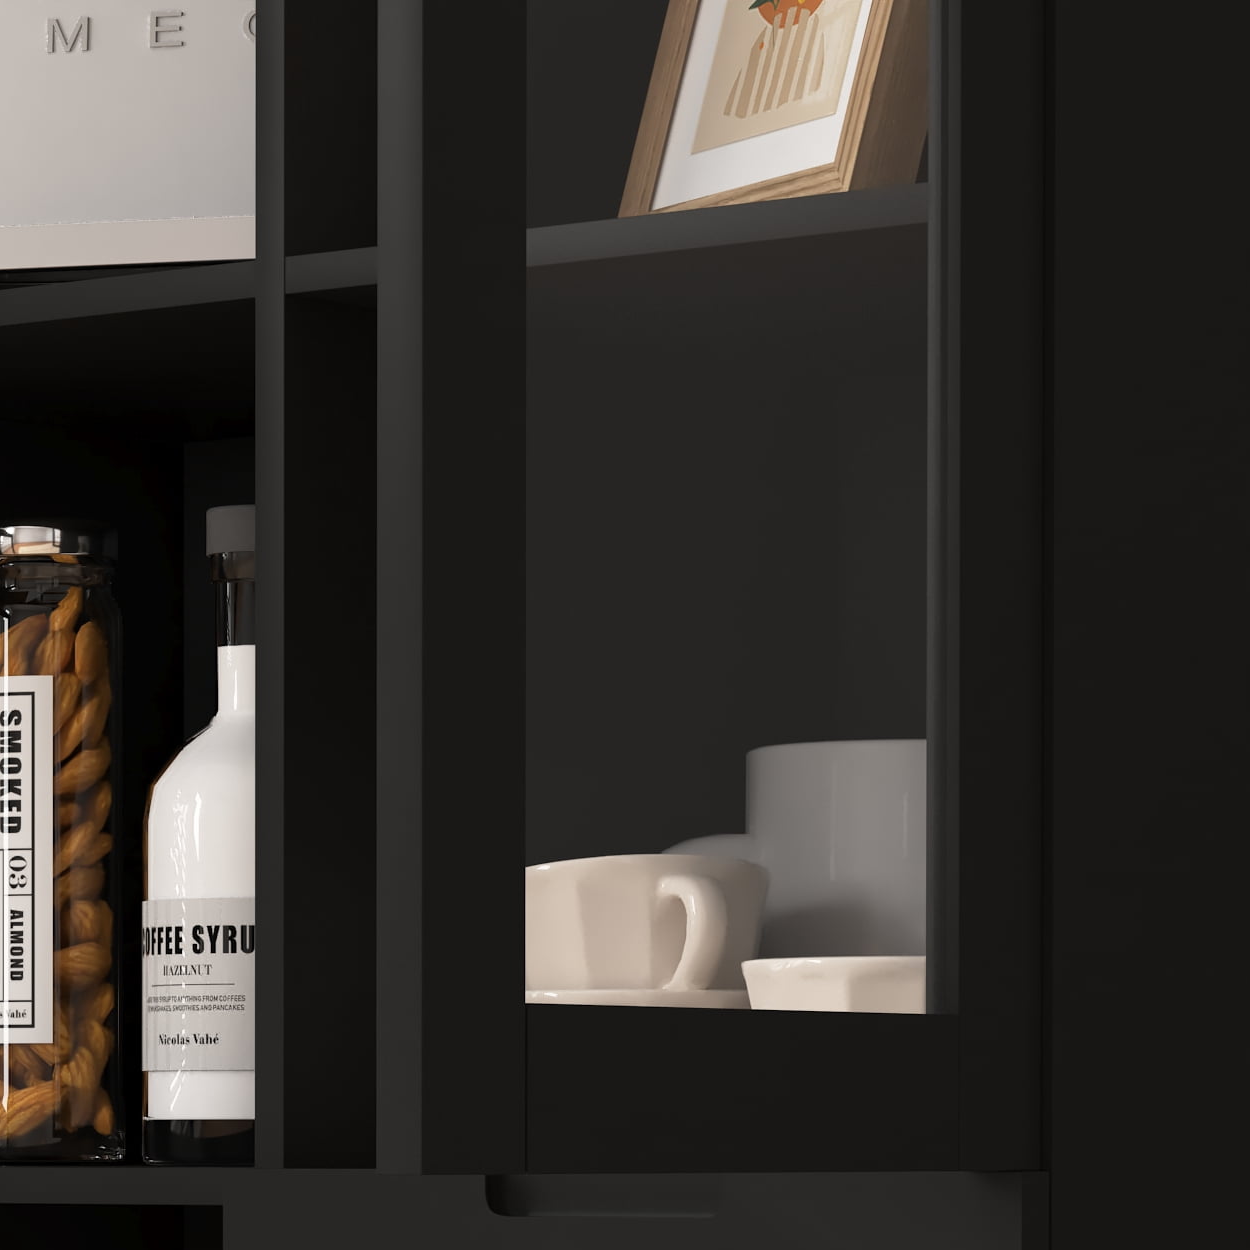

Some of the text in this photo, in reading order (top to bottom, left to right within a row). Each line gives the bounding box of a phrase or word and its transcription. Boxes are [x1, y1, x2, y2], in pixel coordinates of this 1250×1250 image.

[0, 710, 22, 834] SMOKED
[9, 856, 27, 889] 03
[10, 909, 24, 981] ALMOND
[192, 925, 255, 954] SYRU
[163, 964, 212, 976] HAZELNUT
[7, 1009, 26, 1018] ahé
[159, 1033, 219, 1045] Nicolas Vahé
